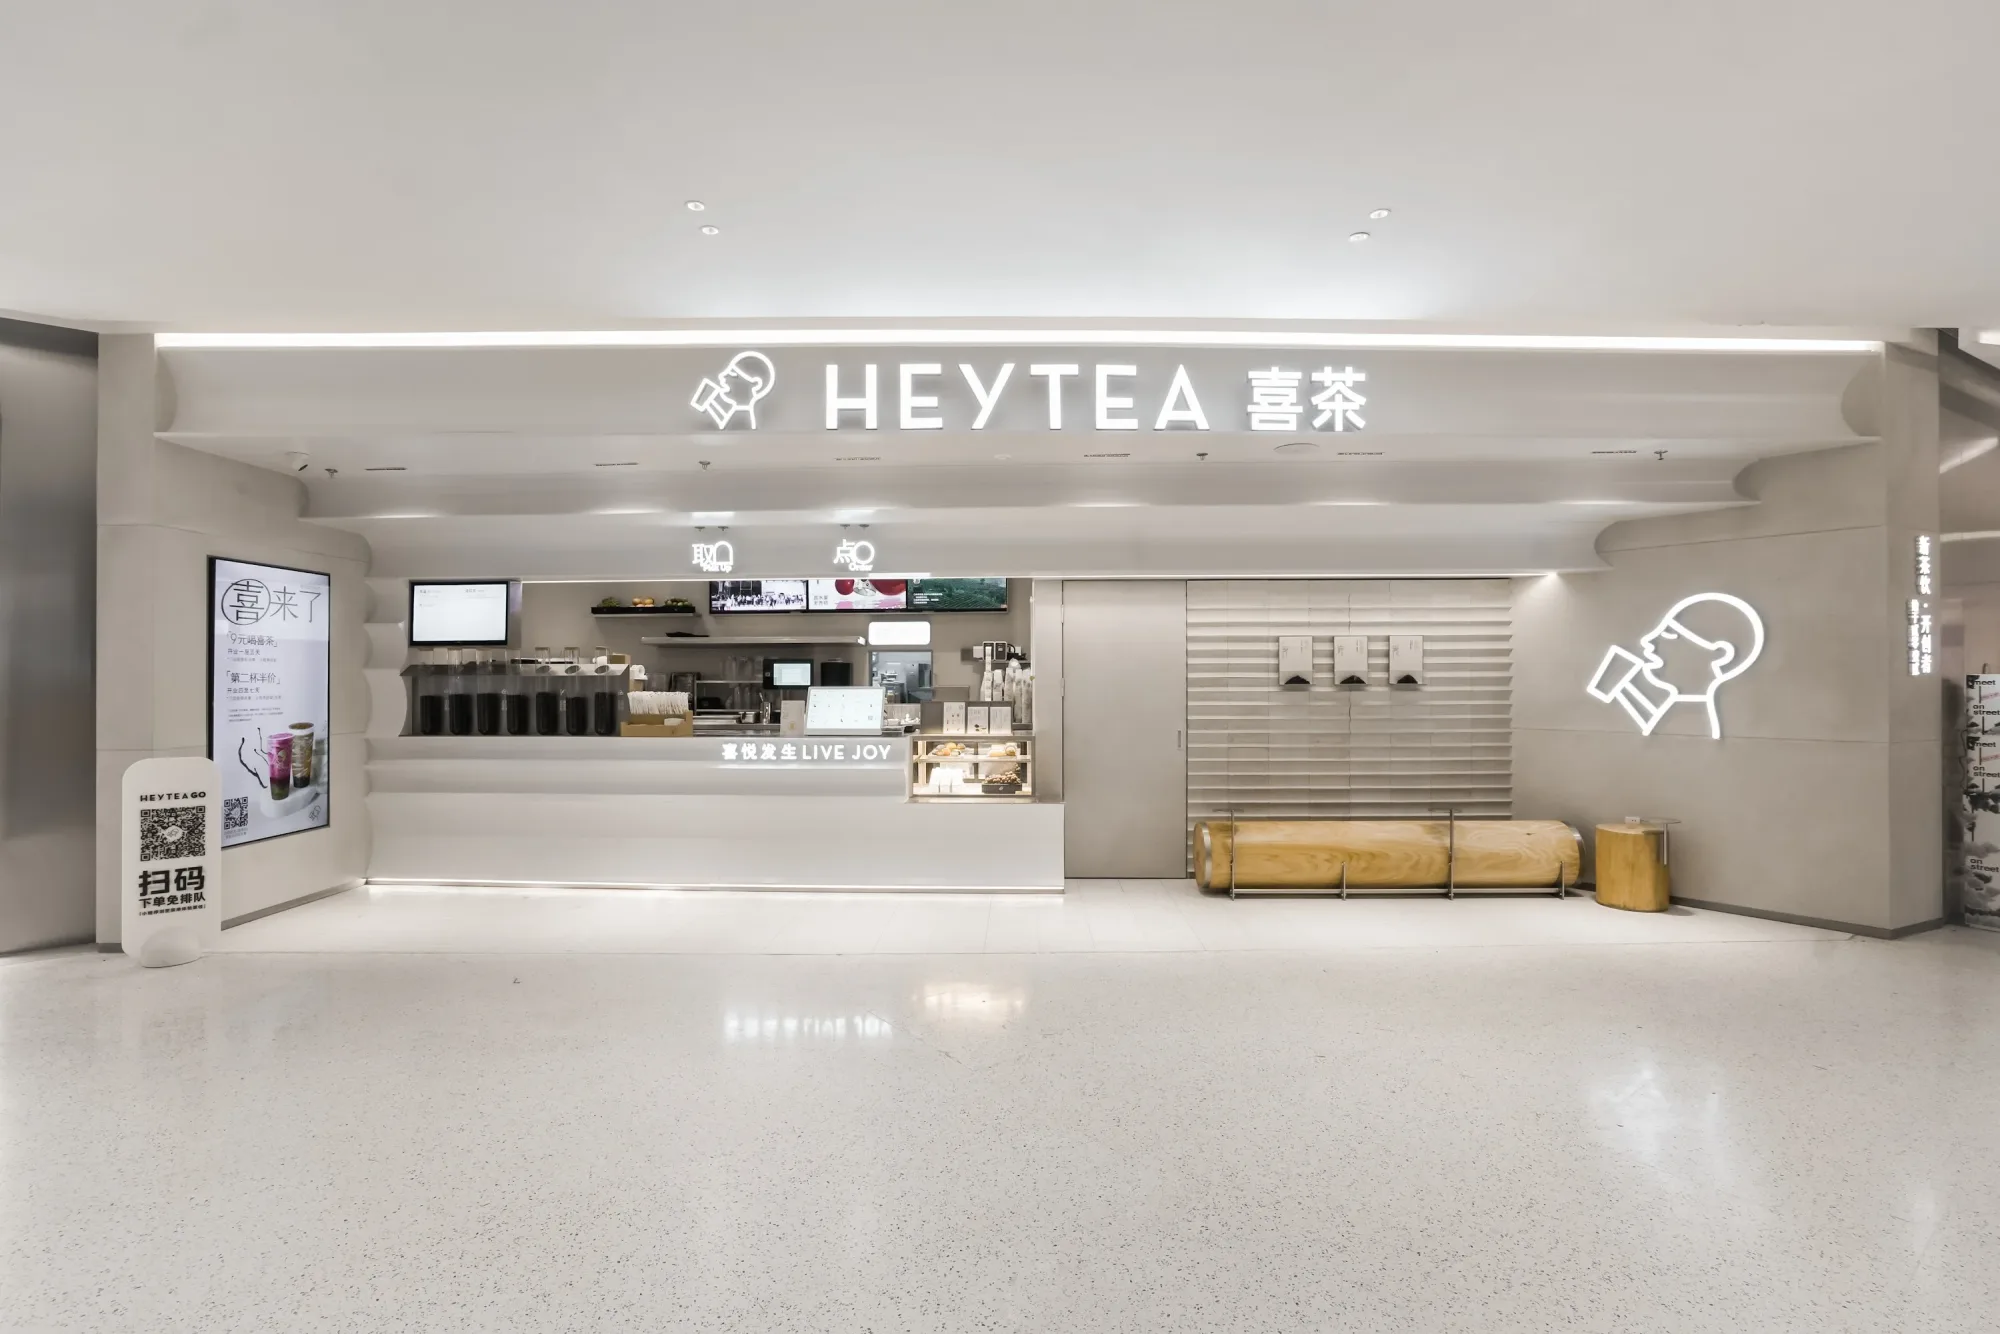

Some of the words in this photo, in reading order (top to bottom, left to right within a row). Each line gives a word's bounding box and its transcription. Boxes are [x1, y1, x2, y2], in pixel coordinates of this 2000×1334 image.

[825, 364, 1209, 431] HEYTEA
[1247, 366, 1367, 433] 喜茶
[228, 580, 322, 623] 喜来了
[721, 742, 797, 761] 喜悦发生
[802, 744, 845, 760] LIVE
[852, 744, 891, 760] JOY
[1970, 864, 2000, 873] street
[138, 866, 205, 897] 扫码
[138, 891, 206, 909] 下单免排队
